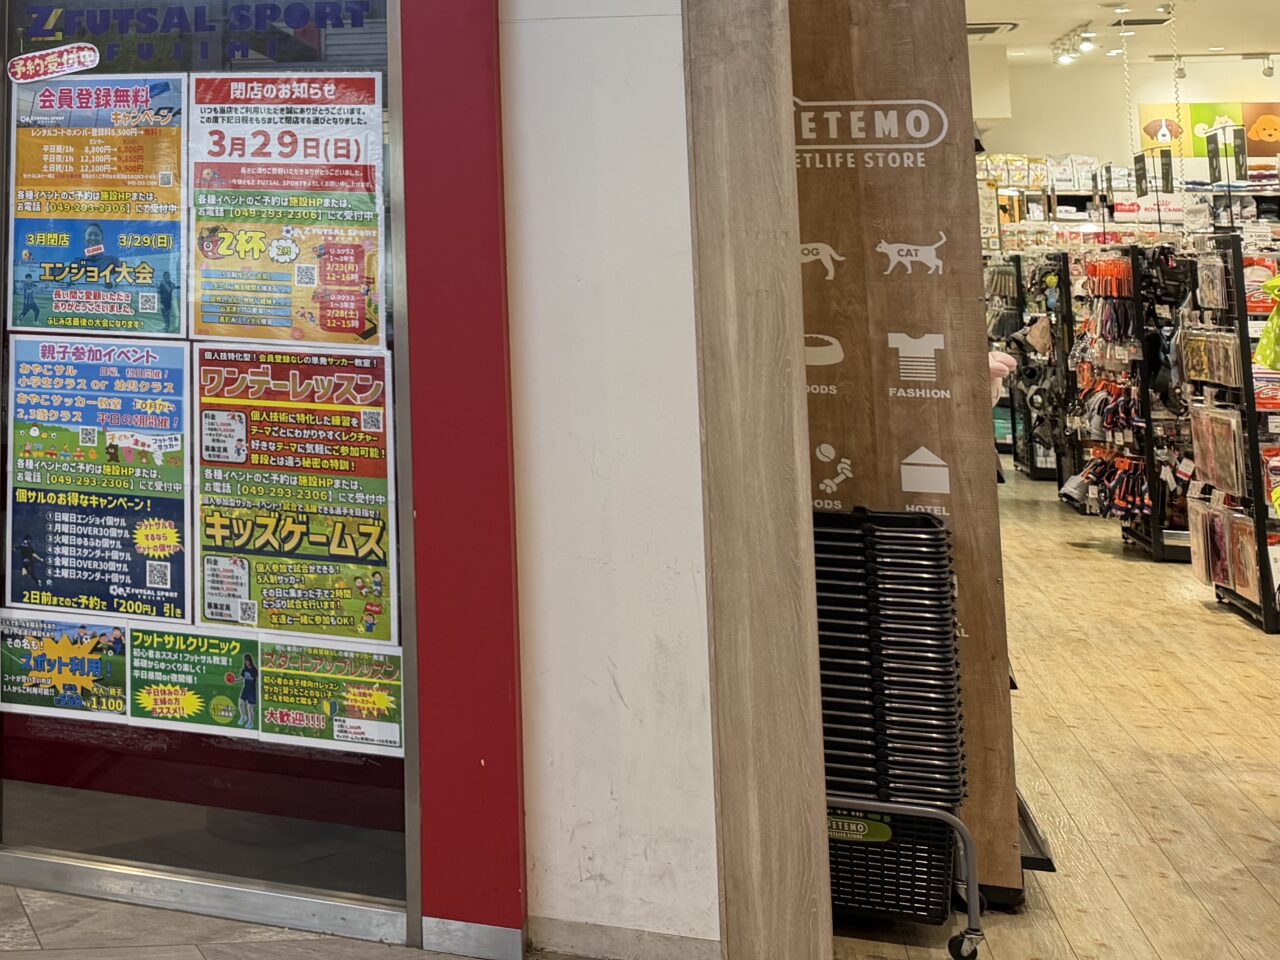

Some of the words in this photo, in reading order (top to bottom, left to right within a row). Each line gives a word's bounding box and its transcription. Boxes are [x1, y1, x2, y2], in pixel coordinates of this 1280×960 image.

[229, 0, 371, 34] SPORT
[9, 49, 96, 79] 予約受付中
[38, 86, 151, 109] 会員登録無料
[230, 82, 337, 99] 閉店のお知らせ
[111, 110, 173, 126] キャンペーン
[794, 109, 930, 139] ETEMO
[864, 152, 926, 168] STORE
[25, 233, 70, 247] 3月閉店
[118, 233, 174, 249] 3/29(日)
[897, 248, 919, 257] CAT
[39, 261, 155, 285] エンジョイ大会
[40, 343, 158, 364] 親子参加イベント
[18, 363, 78, 376] おやこサル
[200, 364, 384, 405] ワンデーレッスン
[889, 388, 952, 399] FASHION
[250, 411, 359, 427] 個人技術に特化した練習を
[250, 425, 379, 442] テーマごとにわかりやすくレクチャー
[812, 499, 842, 509] ODS
[204, 511, 387, 561] キッズゲームズ
[132, 631, 240, 655] フットサルクリニック
